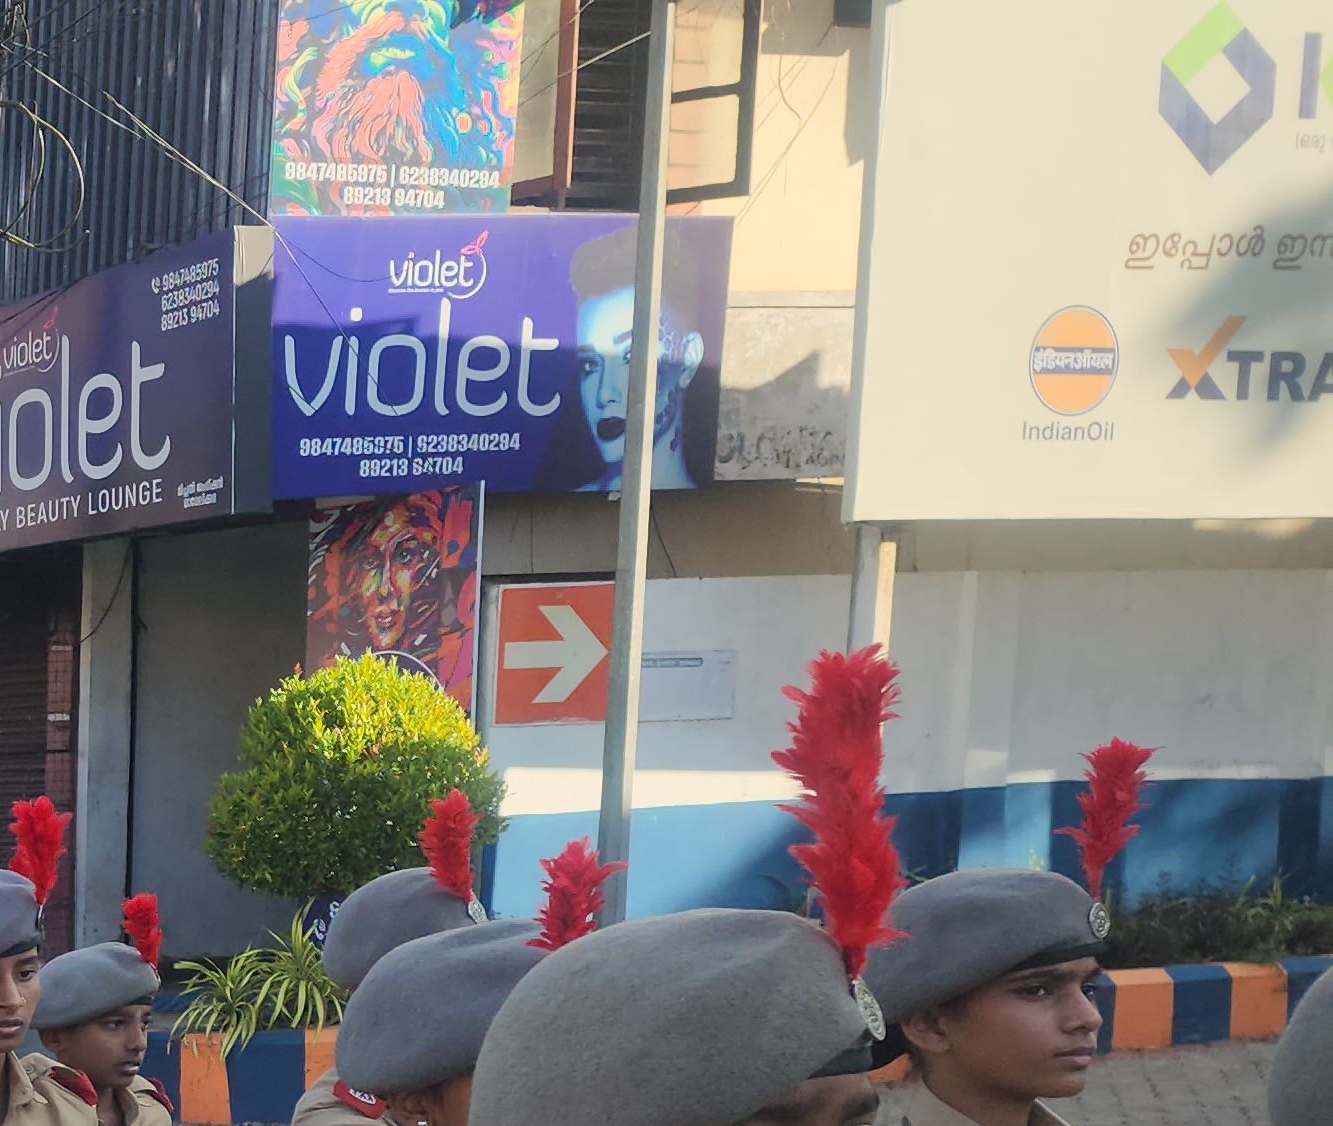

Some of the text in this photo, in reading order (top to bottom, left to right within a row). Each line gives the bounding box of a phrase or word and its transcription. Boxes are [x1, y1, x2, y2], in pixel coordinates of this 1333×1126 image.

[285, 162, 388, 183] 9847485975
[399, 166, 500, 188] 6238340294
[343, 186, 444, 209] 89213 94704
[1124, 224, 1265, 270] ഇപ്പോൾ
[163, 258, 219, 291] 9847485975
[390, 249, 474, 287] violet
[161, 278, 219, 311] 6238340294
[161, 299, 219, 331] 89213 94704
[3, 330, 52, 369] violet
[285, 297, 561, 416] violet
[1033, 348, 1114, 373] इंडियनऑयल
[300, 435, 404, 457] 9847485975
[417, 432, 521, 453] 6238340294
[1022, 421, 1115, 441] IndianOil
[360, 456, 464, 478] 89213 94704
[16, 495, 81, 528] BEAUTY
[88, 478, 163, 515] LOUNGE
